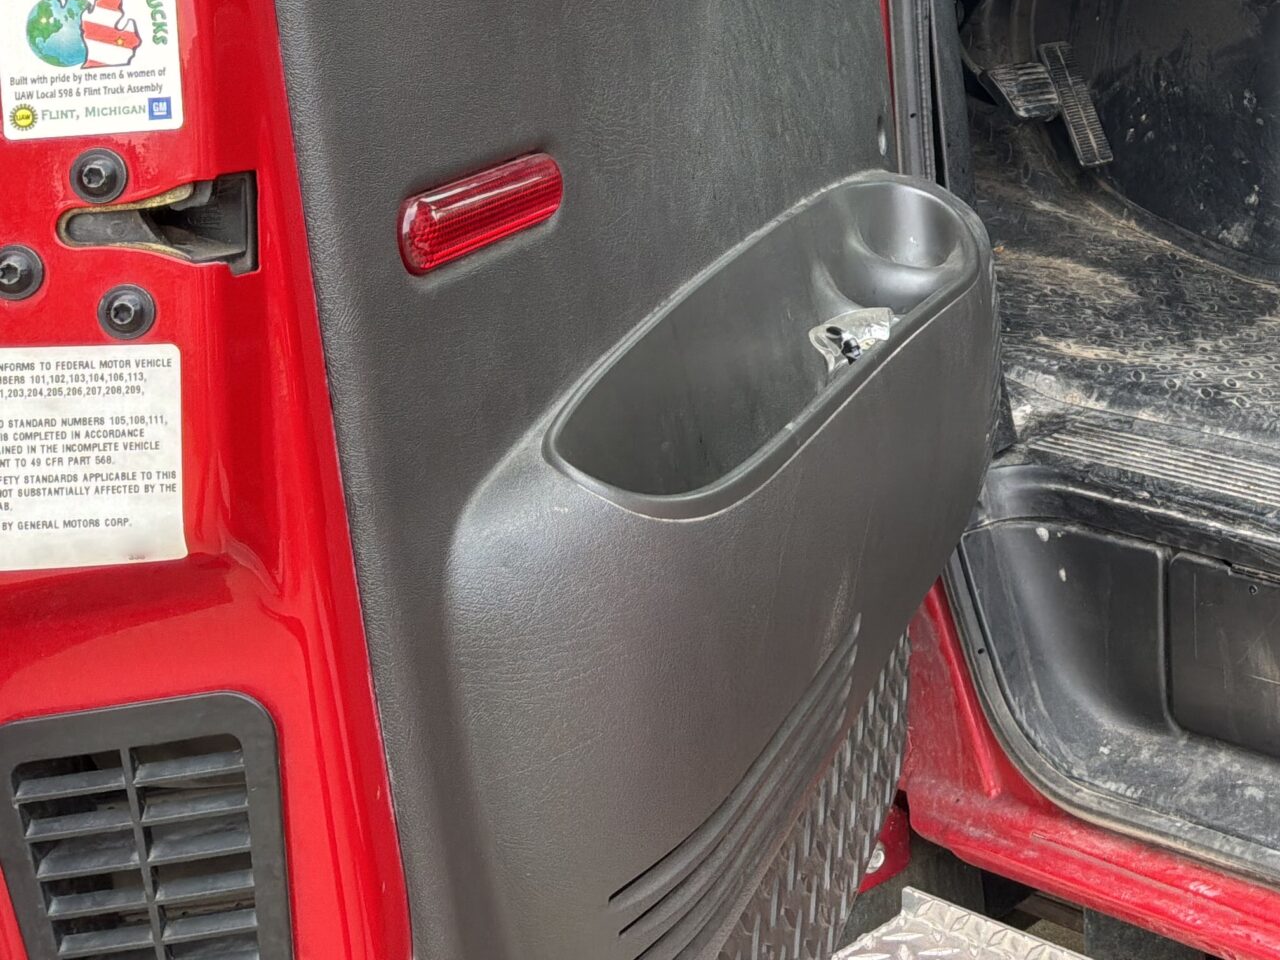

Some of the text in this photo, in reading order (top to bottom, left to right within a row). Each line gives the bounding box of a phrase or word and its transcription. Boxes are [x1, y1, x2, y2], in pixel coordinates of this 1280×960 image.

[10, 76, 28, 86] Built
[30, 75, 48, 85] with
[50, 73, 71, 86] pride
[73, 73, 82, 84] by
[84, 72, 98, 81] the
[99, 72, 117, 80] men
[126, 70, 156, 78] women
[157, 67, 166, 77] of
[14, 90, 34, 101] UAW
[36, 89, 56, 100] Local
[58, 88, 74, 98] 598
[83, 87, 101, 97] Flint
[102, 84, 125, 95] Truck
[126, 82, 163, 94] Assembly
[41, 108, 80, 121] FLINT,
[84, 104, 146, 118] MICHIGAN
[152, 101, 168, 113] GM
[40, 361, 52, 371] TO
[55, 360, 96, 371] FEDERAL
[99, 359, 131, 369] MOTOR
[134, 358, 172, 368] VEHICLE
[8, 418, 57, 429] STANDARD
[61, 416, 105, 427] NUMBERS
[13, 430, 67, 441] COMPLETED
[71, 430, 81, 440] IN
[84, 428, 145, 440] ACCORDANCE
[0, 441, 160, 455] INED IN THE INCOMPLETE VEHICLE
[15, 458, 27, 468] TO
[31, 457, 41, 467] 49
[45, 457, 64, 467] CFR
[68, 456, 91, 466] PART
[24, 473, 78, 484] STANDARDS
[82, 471, 137, 483] APPLICABLE
[140, 471, 152, 480] TO
[156, 470, 176, 480] THIS
[17, 486, 91, 497] SUBSTANTIALLY
[94, 484, 140, 495] AFFECTED
[144, 484, 155, 493] BY
[160, 483, 176, 493] THE
[2, 517, 132, 531] BY GENERAL MOTORS CORP.
